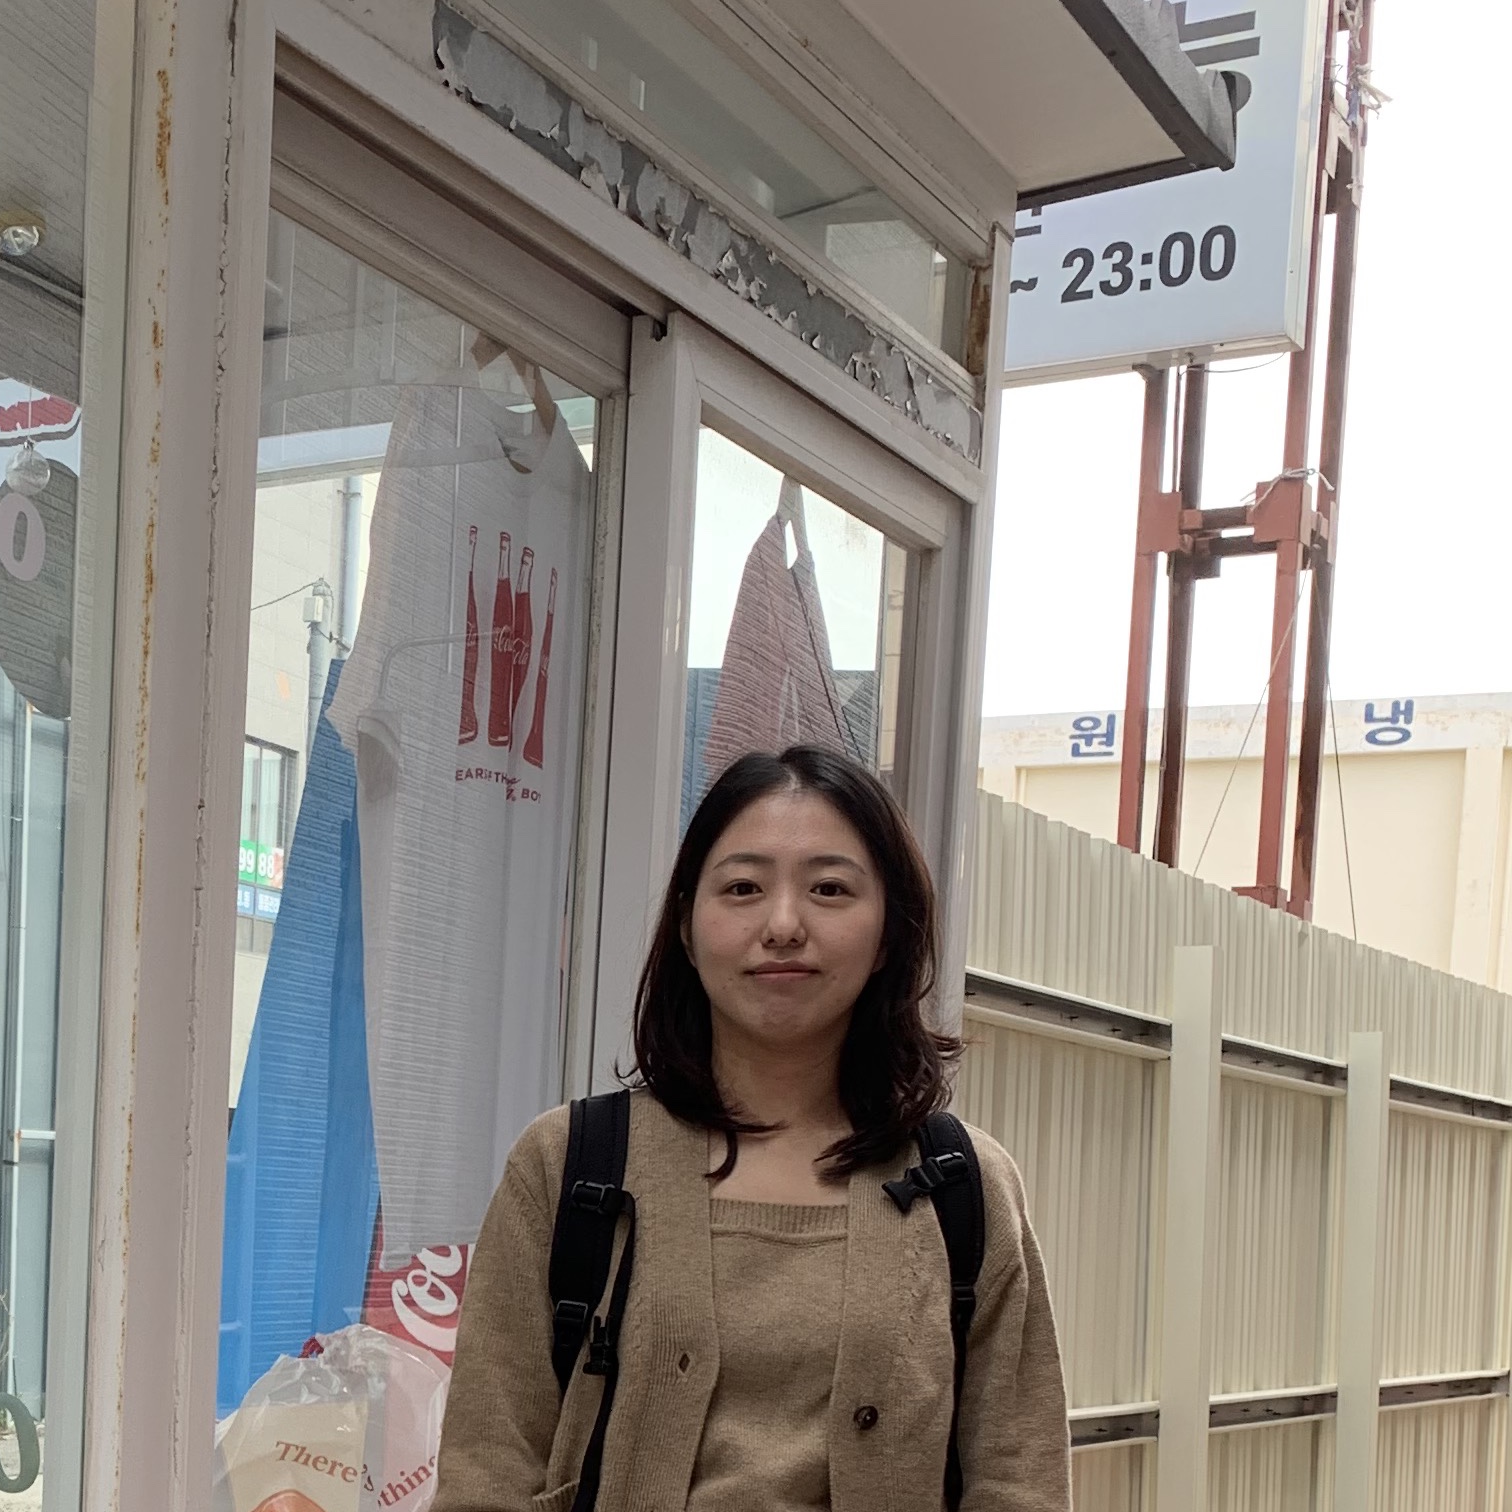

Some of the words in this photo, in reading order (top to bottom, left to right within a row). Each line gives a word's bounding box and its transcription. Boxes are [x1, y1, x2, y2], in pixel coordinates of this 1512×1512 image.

[1061, 225, 1236, 304] 23:00
[1069, 714, 1116, 757] 원
[1365, 700, 1414, 746] 냉
